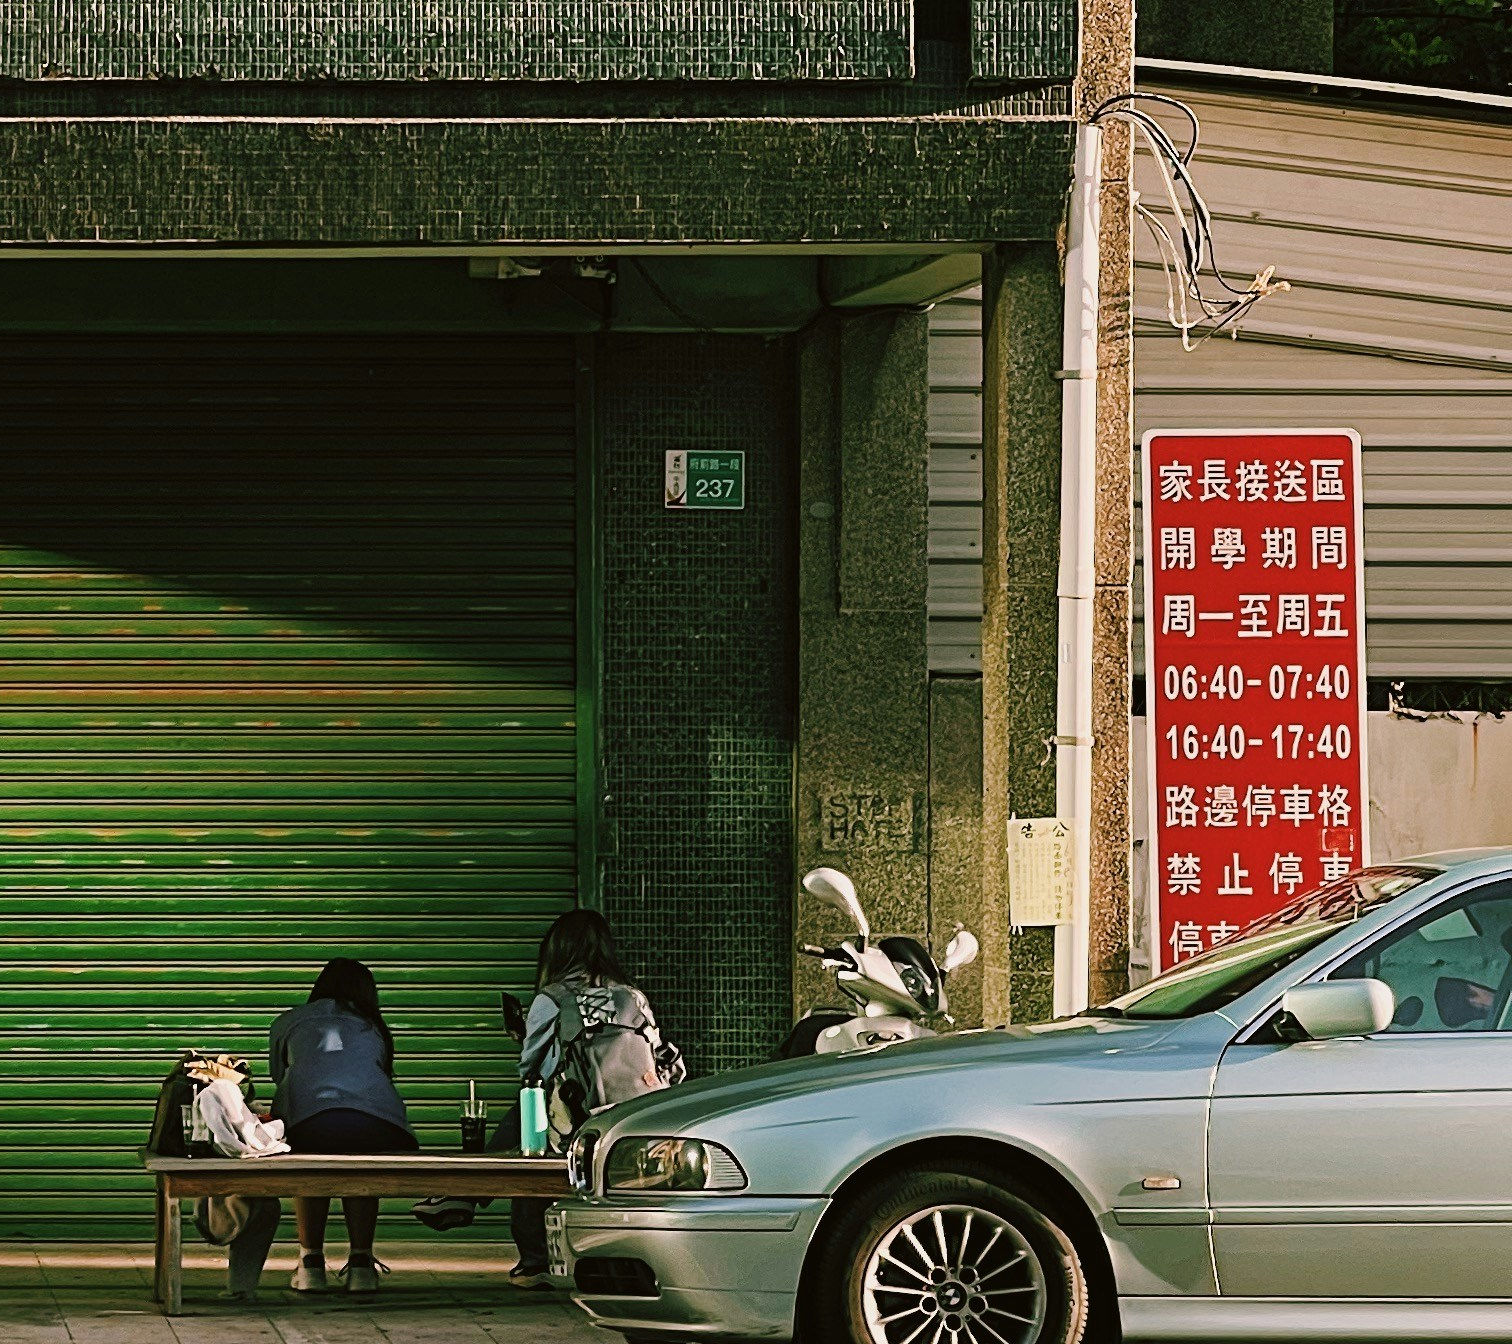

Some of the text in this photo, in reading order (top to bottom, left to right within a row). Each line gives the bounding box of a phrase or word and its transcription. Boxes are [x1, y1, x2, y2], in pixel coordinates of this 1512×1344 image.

[696, 479, 735, 498] 237
[1159, 459, 1346, 503] 家長接送區
[1160, 527, 1347, 570] 開學期間
[1162, 594, 1349, 639] 周一至周五
[1165, 784, 1352, 828] 路邊停車格
[1167, 852, 1353, 895] 禁止停車
